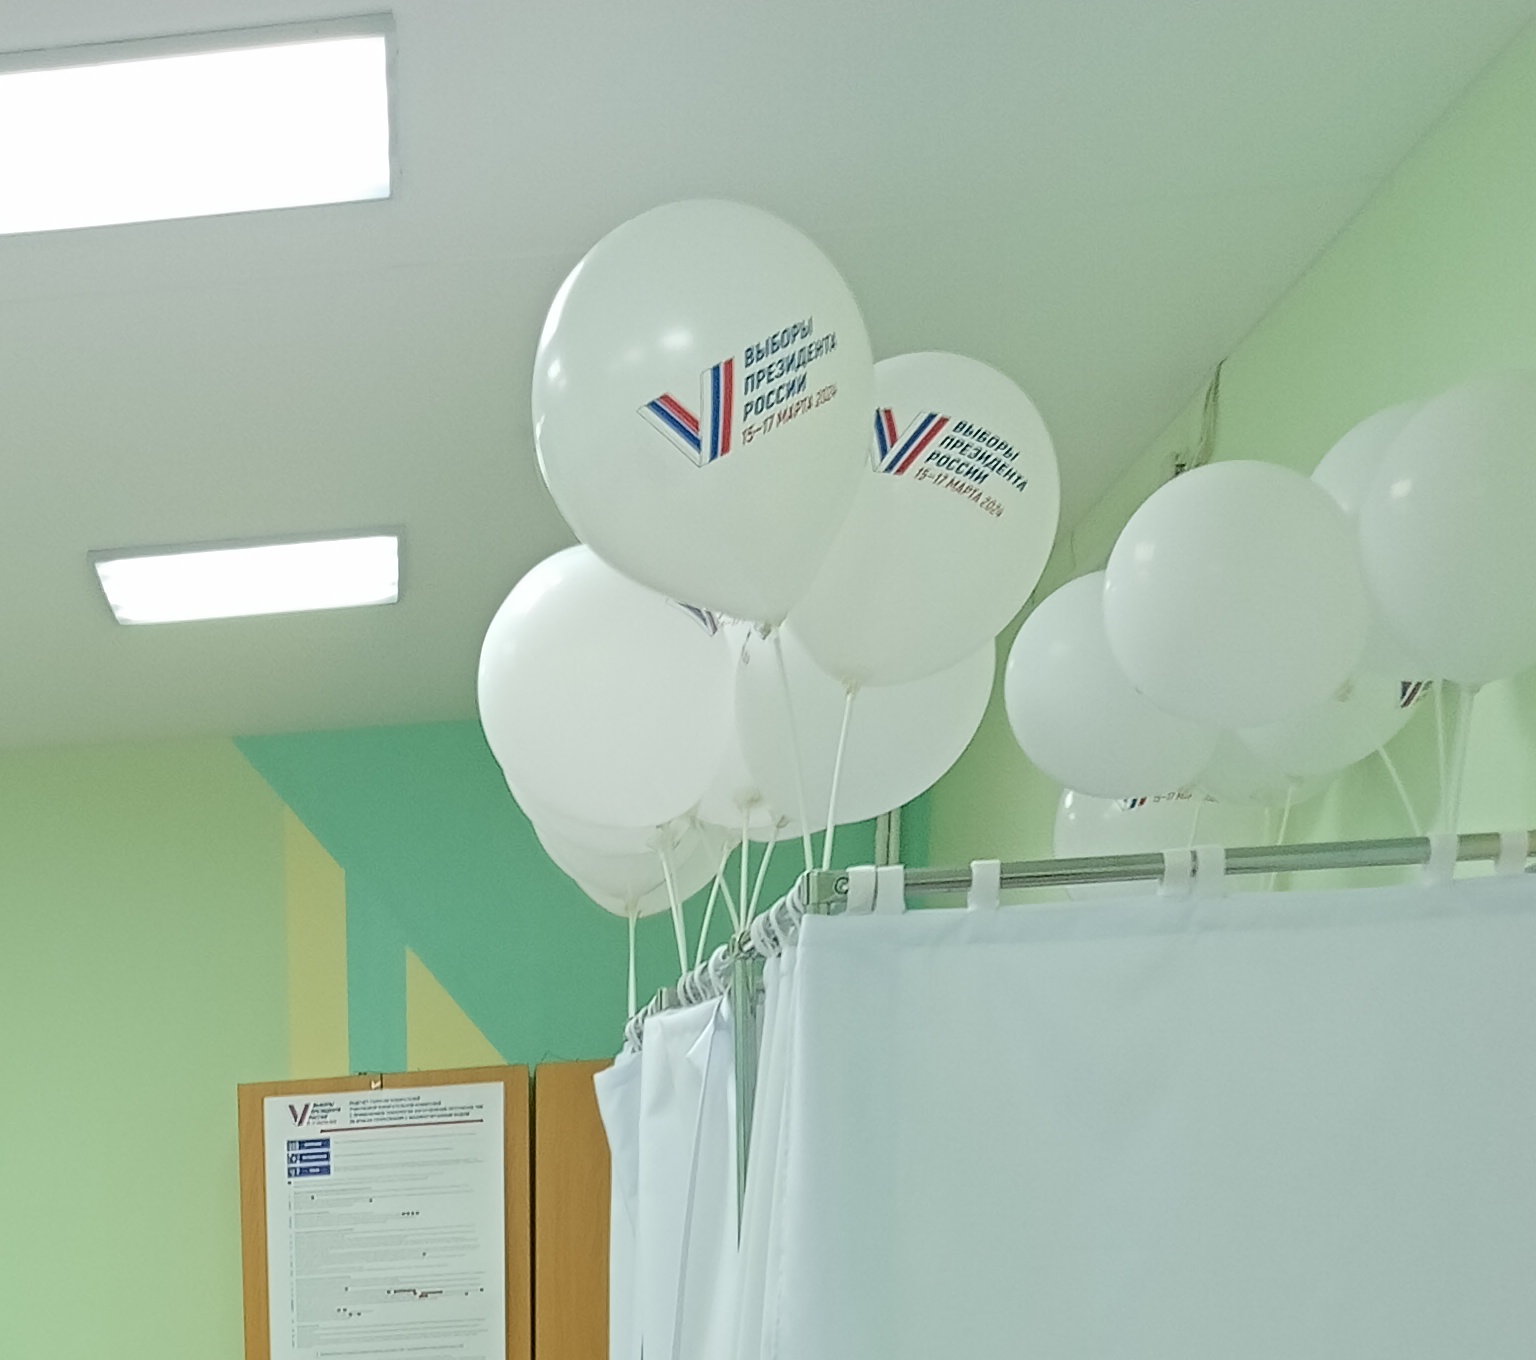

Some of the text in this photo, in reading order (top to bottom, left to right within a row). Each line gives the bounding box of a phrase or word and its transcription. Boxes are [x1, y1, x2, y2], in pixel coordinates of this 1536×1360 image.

[743, 316, 814, 369] ВЫБОРЫ
[743, 332, 837, 396] ПРЕЗИДЕНТА
[743, 372, 808, 422] РОССИИ
[939, 434, 1029, 493] ПРЕЗИДЕНТА
[951, 419, 1021, 462] ВЫБОРЫ
[924, 449, 989, 485] РОССИИ
[945, 477, 984, 504] МАРТА
